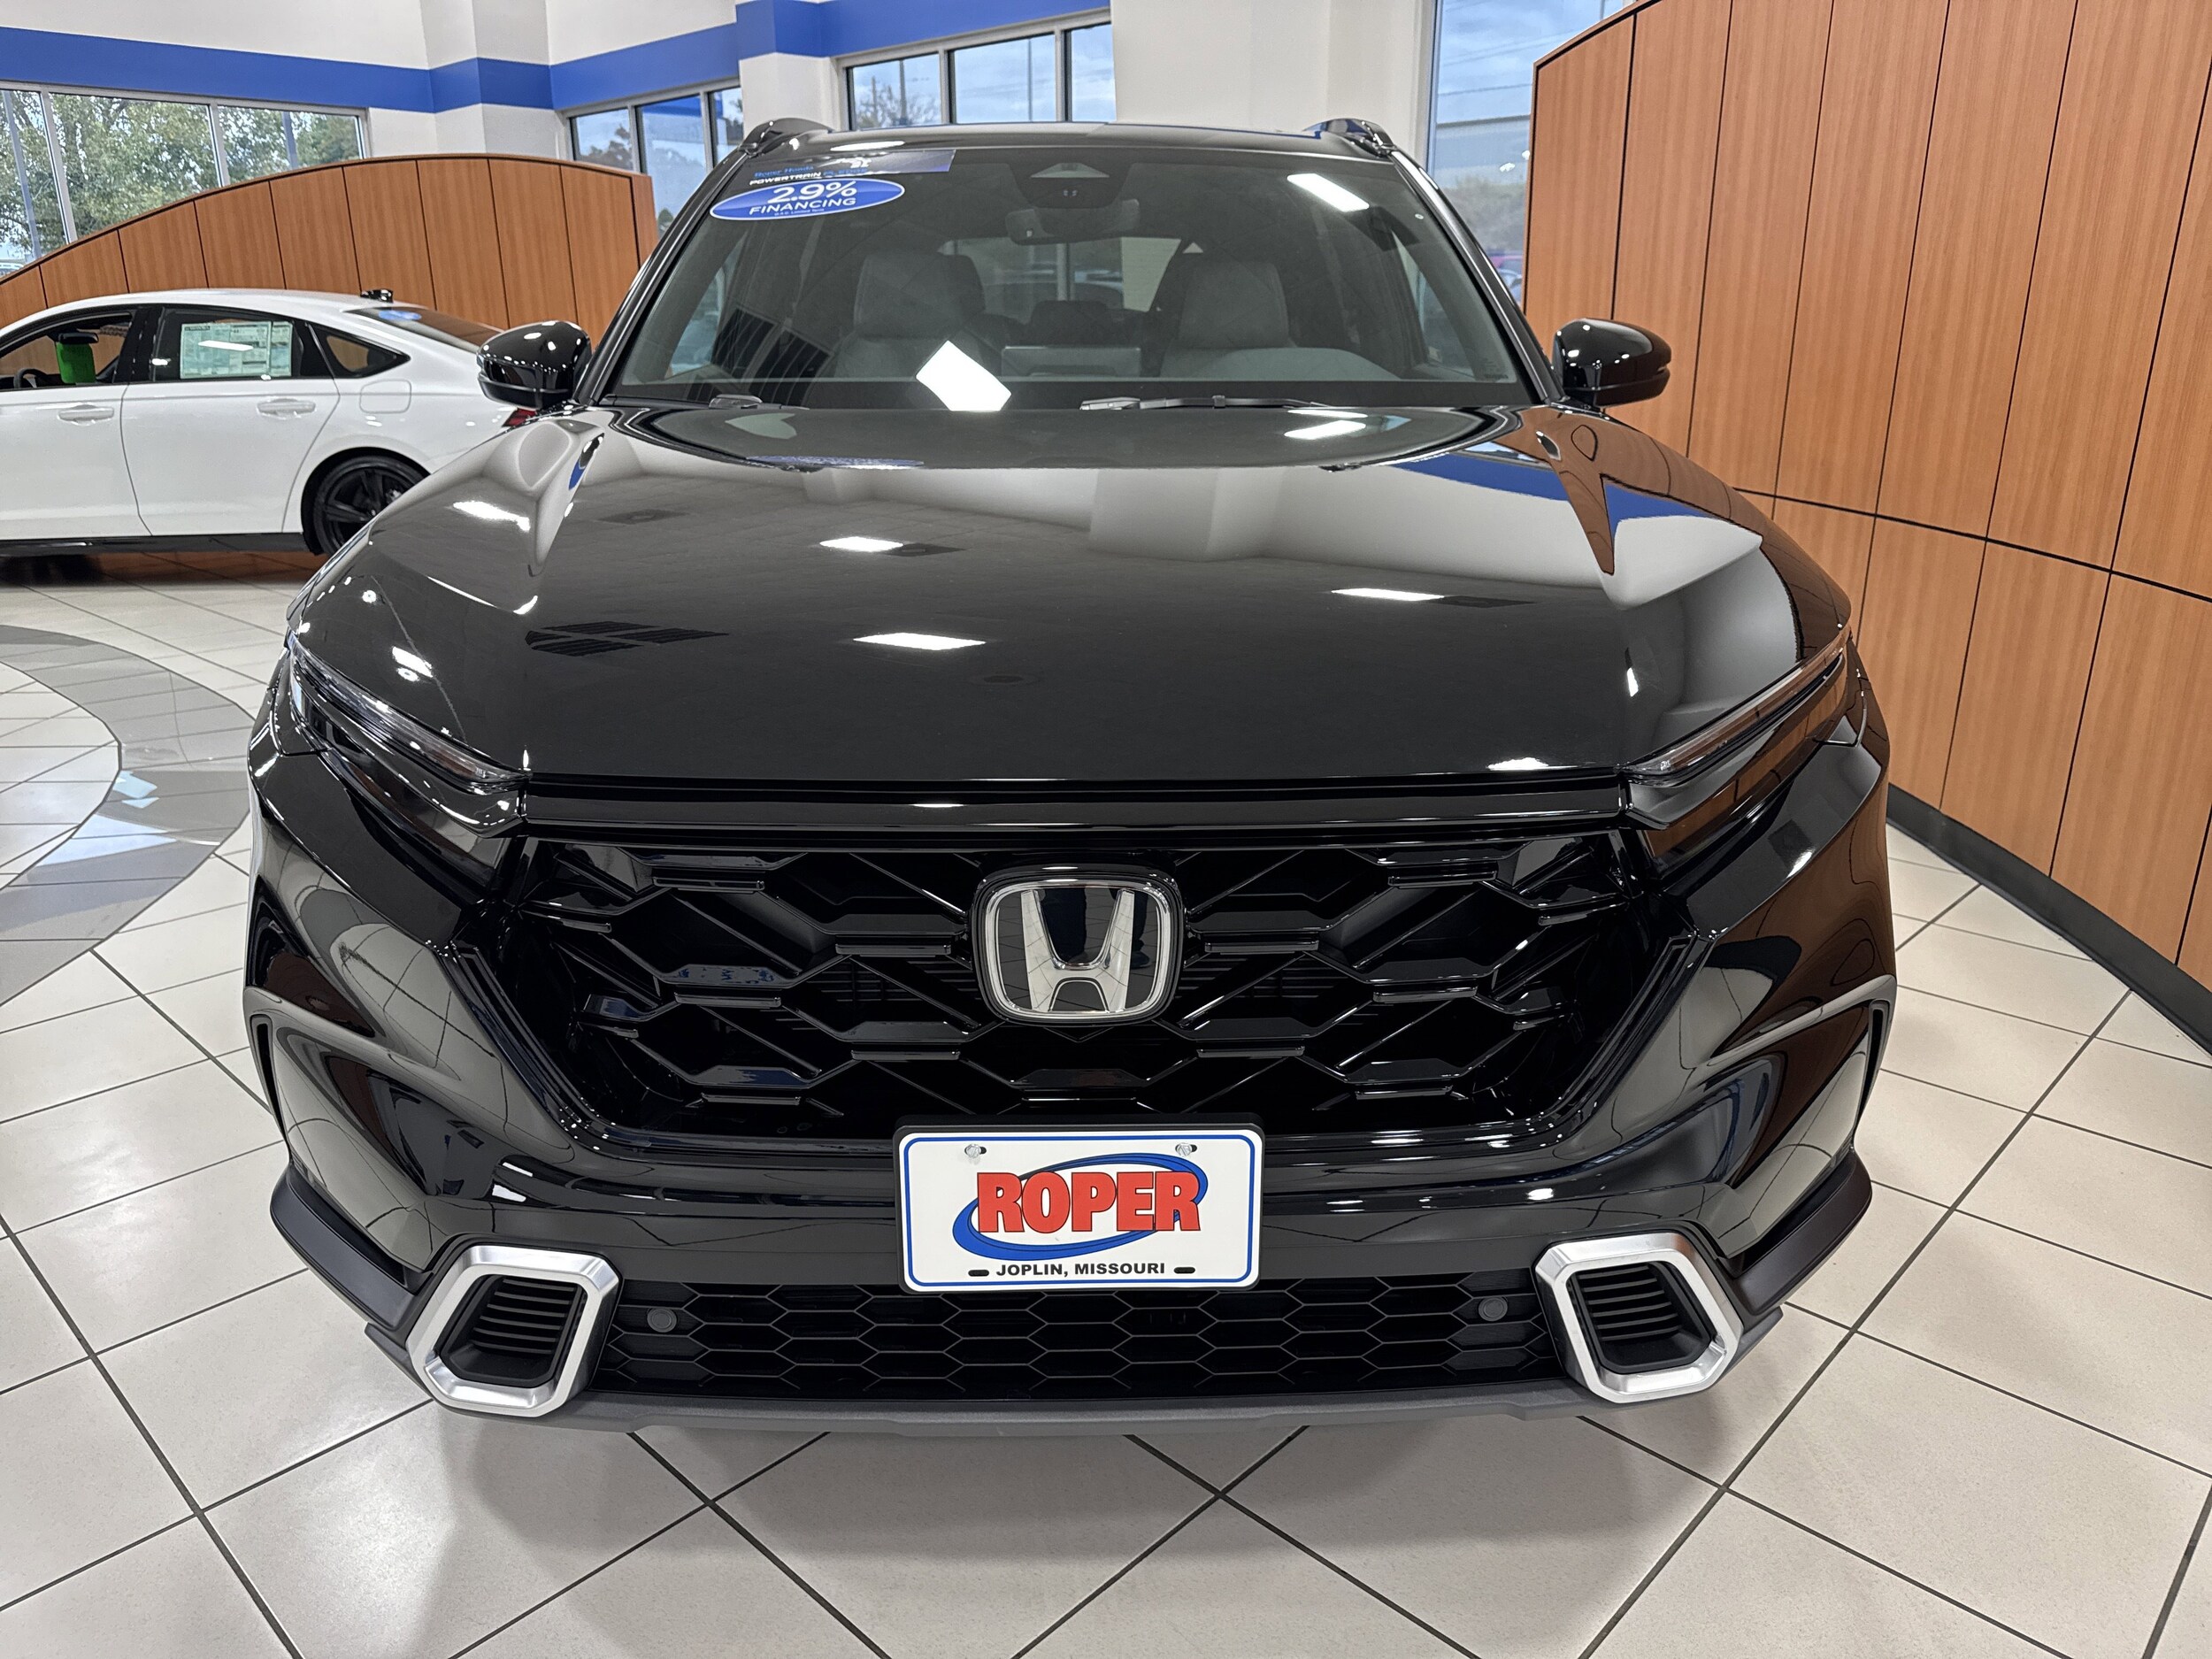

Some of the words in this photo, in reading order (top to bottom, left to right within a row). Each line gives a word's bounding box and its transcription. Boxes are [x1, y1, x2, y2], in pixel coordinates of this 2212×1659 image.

[749, 172, 822, 186] POWERTRAIN
[767, 180, 857, 204] 2.9%
[749, 197, 856, 215] FINANCING
[976, 1171, 1202, 1233] ROPER
[995, 1263, 1069, 1278] JOPLIN,
[1074, 1263, 1165, 1275] MISSOURI
